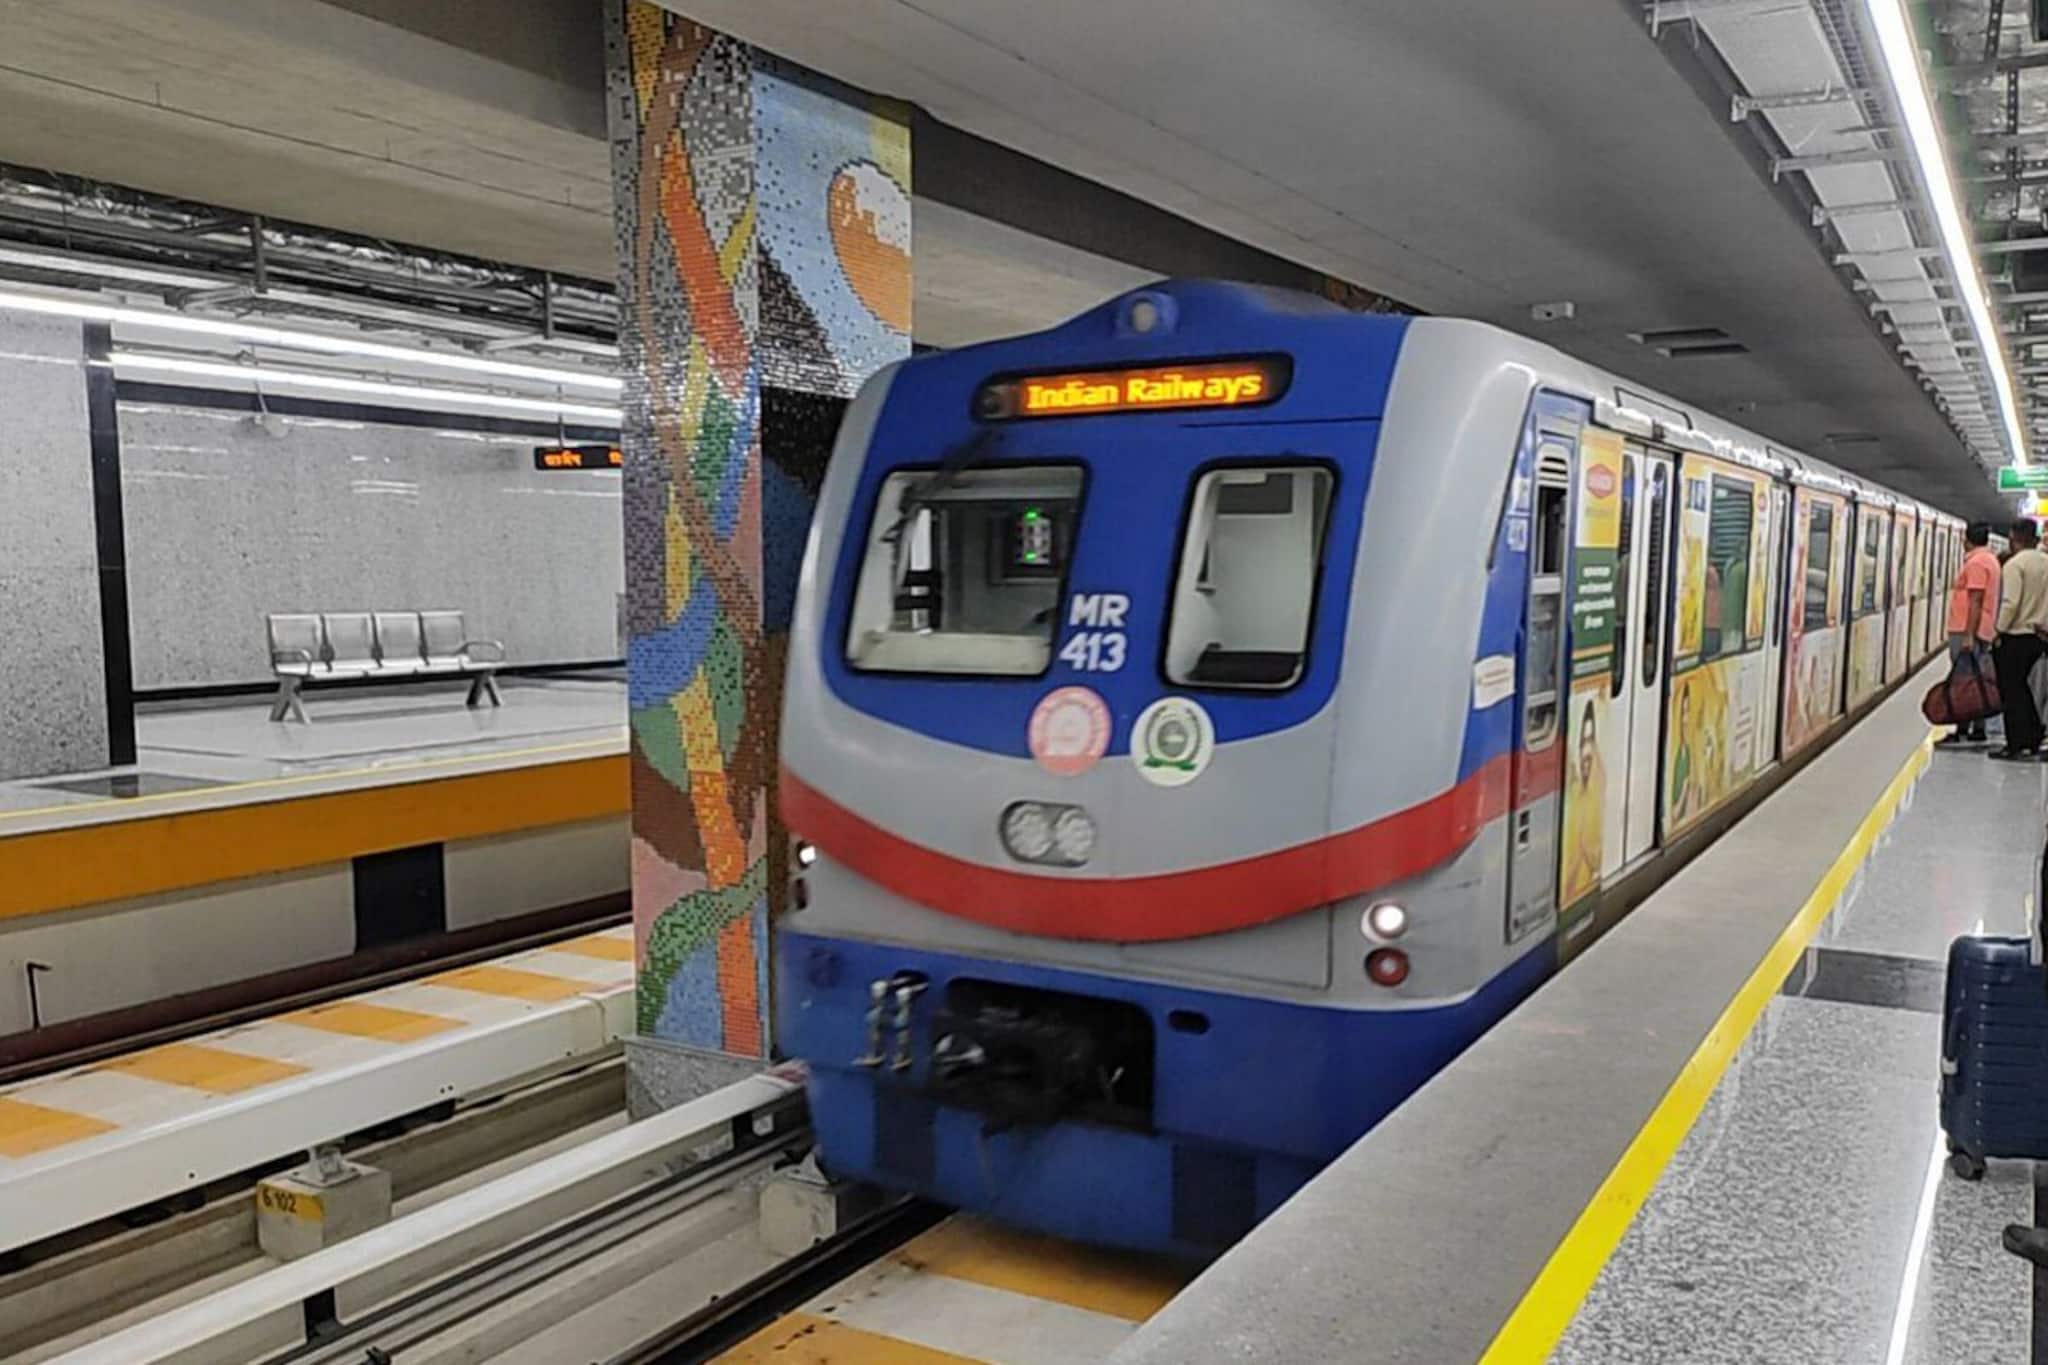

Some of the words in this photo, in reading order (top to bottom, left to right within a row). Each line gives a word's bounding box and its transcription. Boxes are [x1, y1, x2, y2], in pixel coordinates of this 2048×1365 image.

[1027, 381, 1119, 409] Indian
[1127, 373, 1262, 404] Railways
[1069, 594, 1129, 628] MR
[1059, 632, 1127, 672] 413
